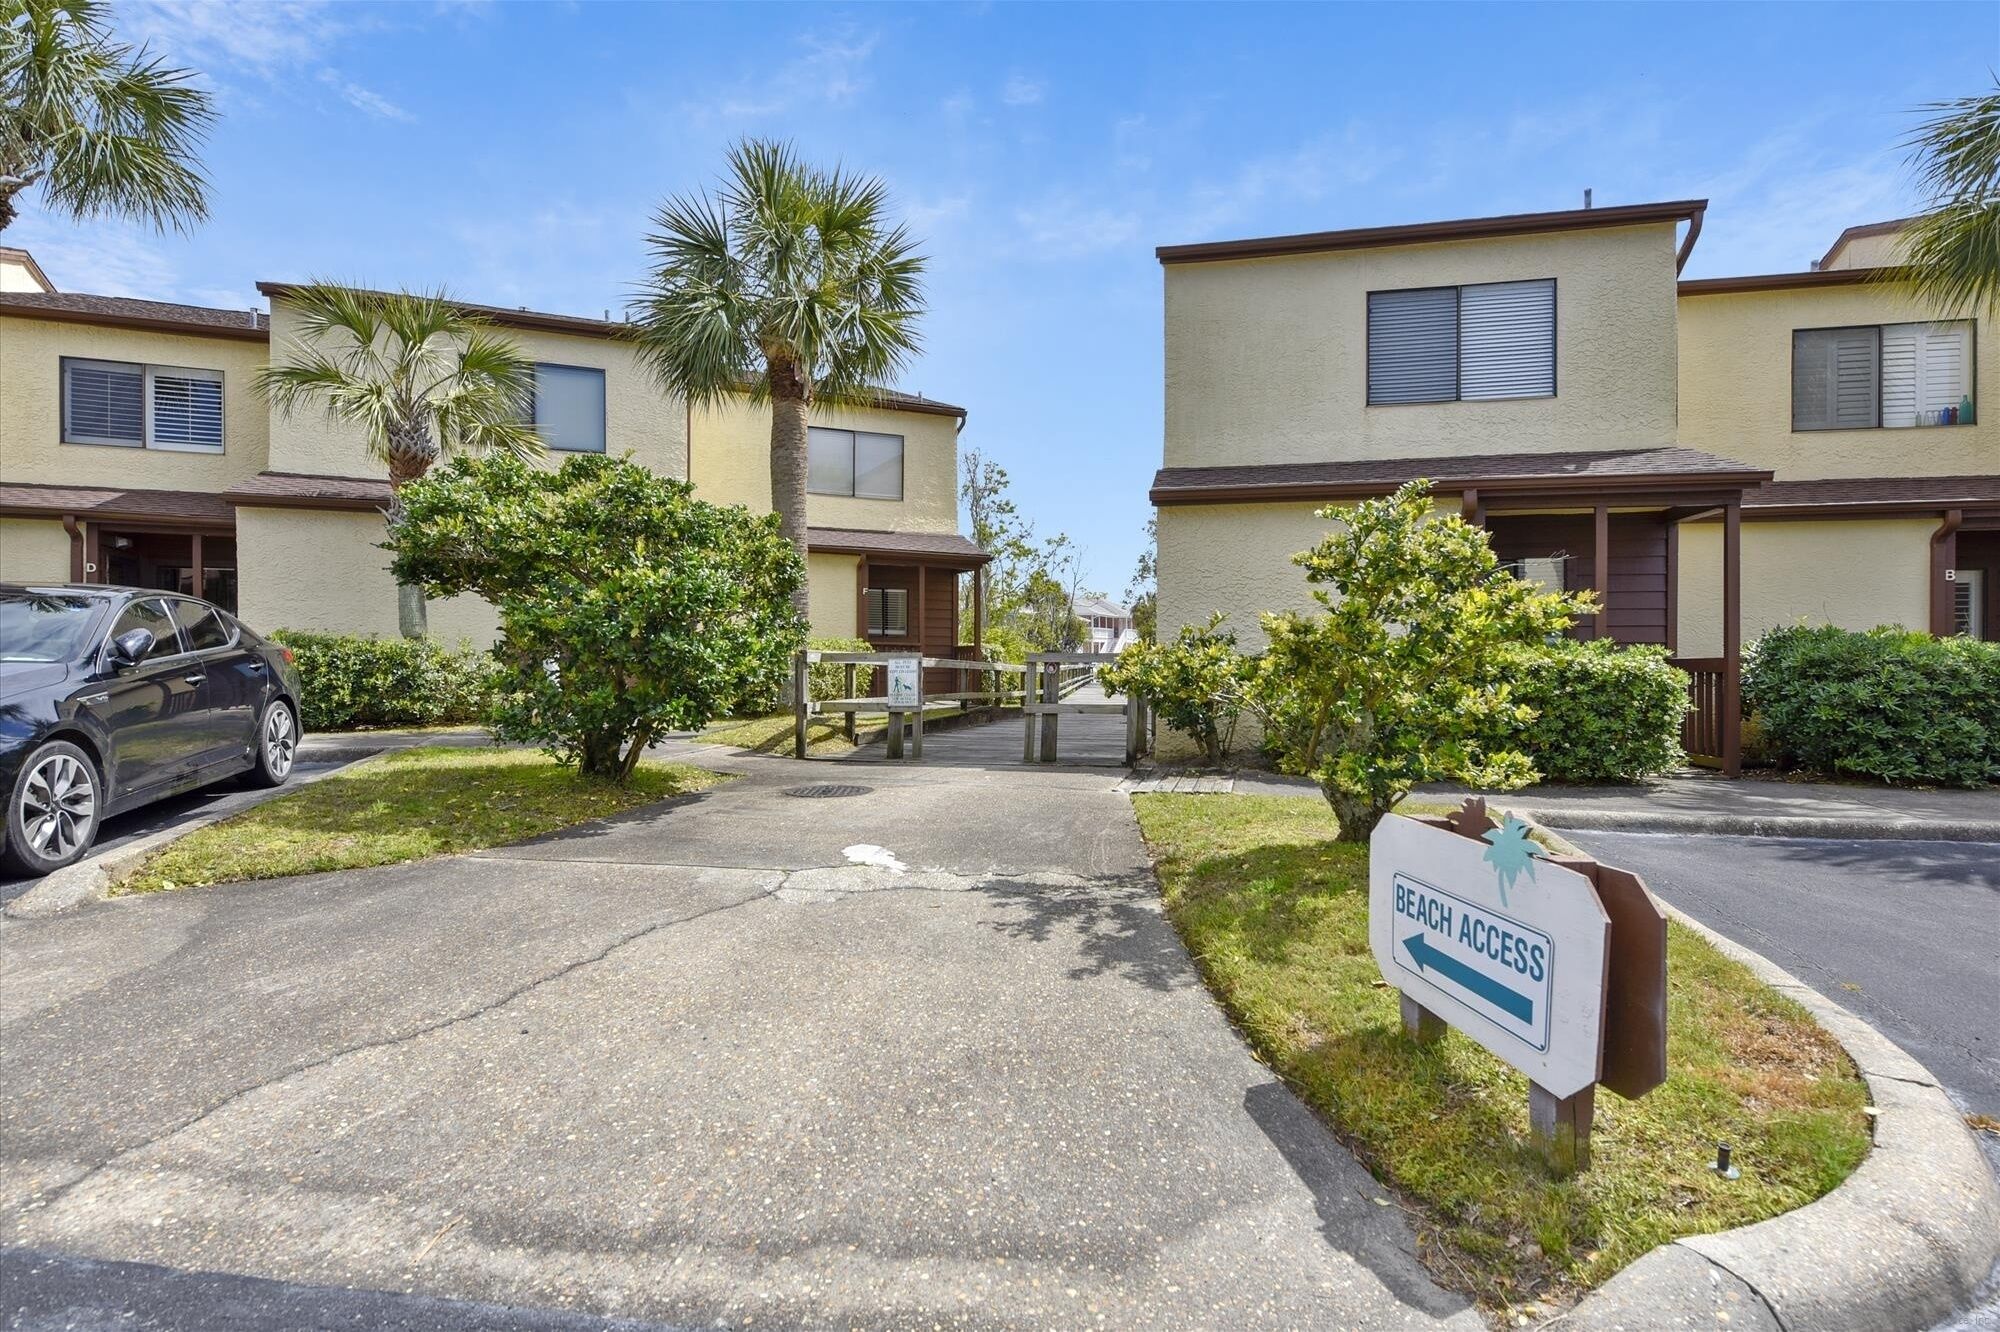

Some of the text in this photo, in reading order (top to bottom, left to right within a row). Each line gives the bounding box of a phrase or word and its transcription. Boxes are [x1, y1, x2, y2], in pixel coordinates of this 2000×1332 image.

[86, 562, 97, 573] D
[1945, 569, 1956, 581] B
[1396, 884, 1545, 983] BEACH ACCESS
